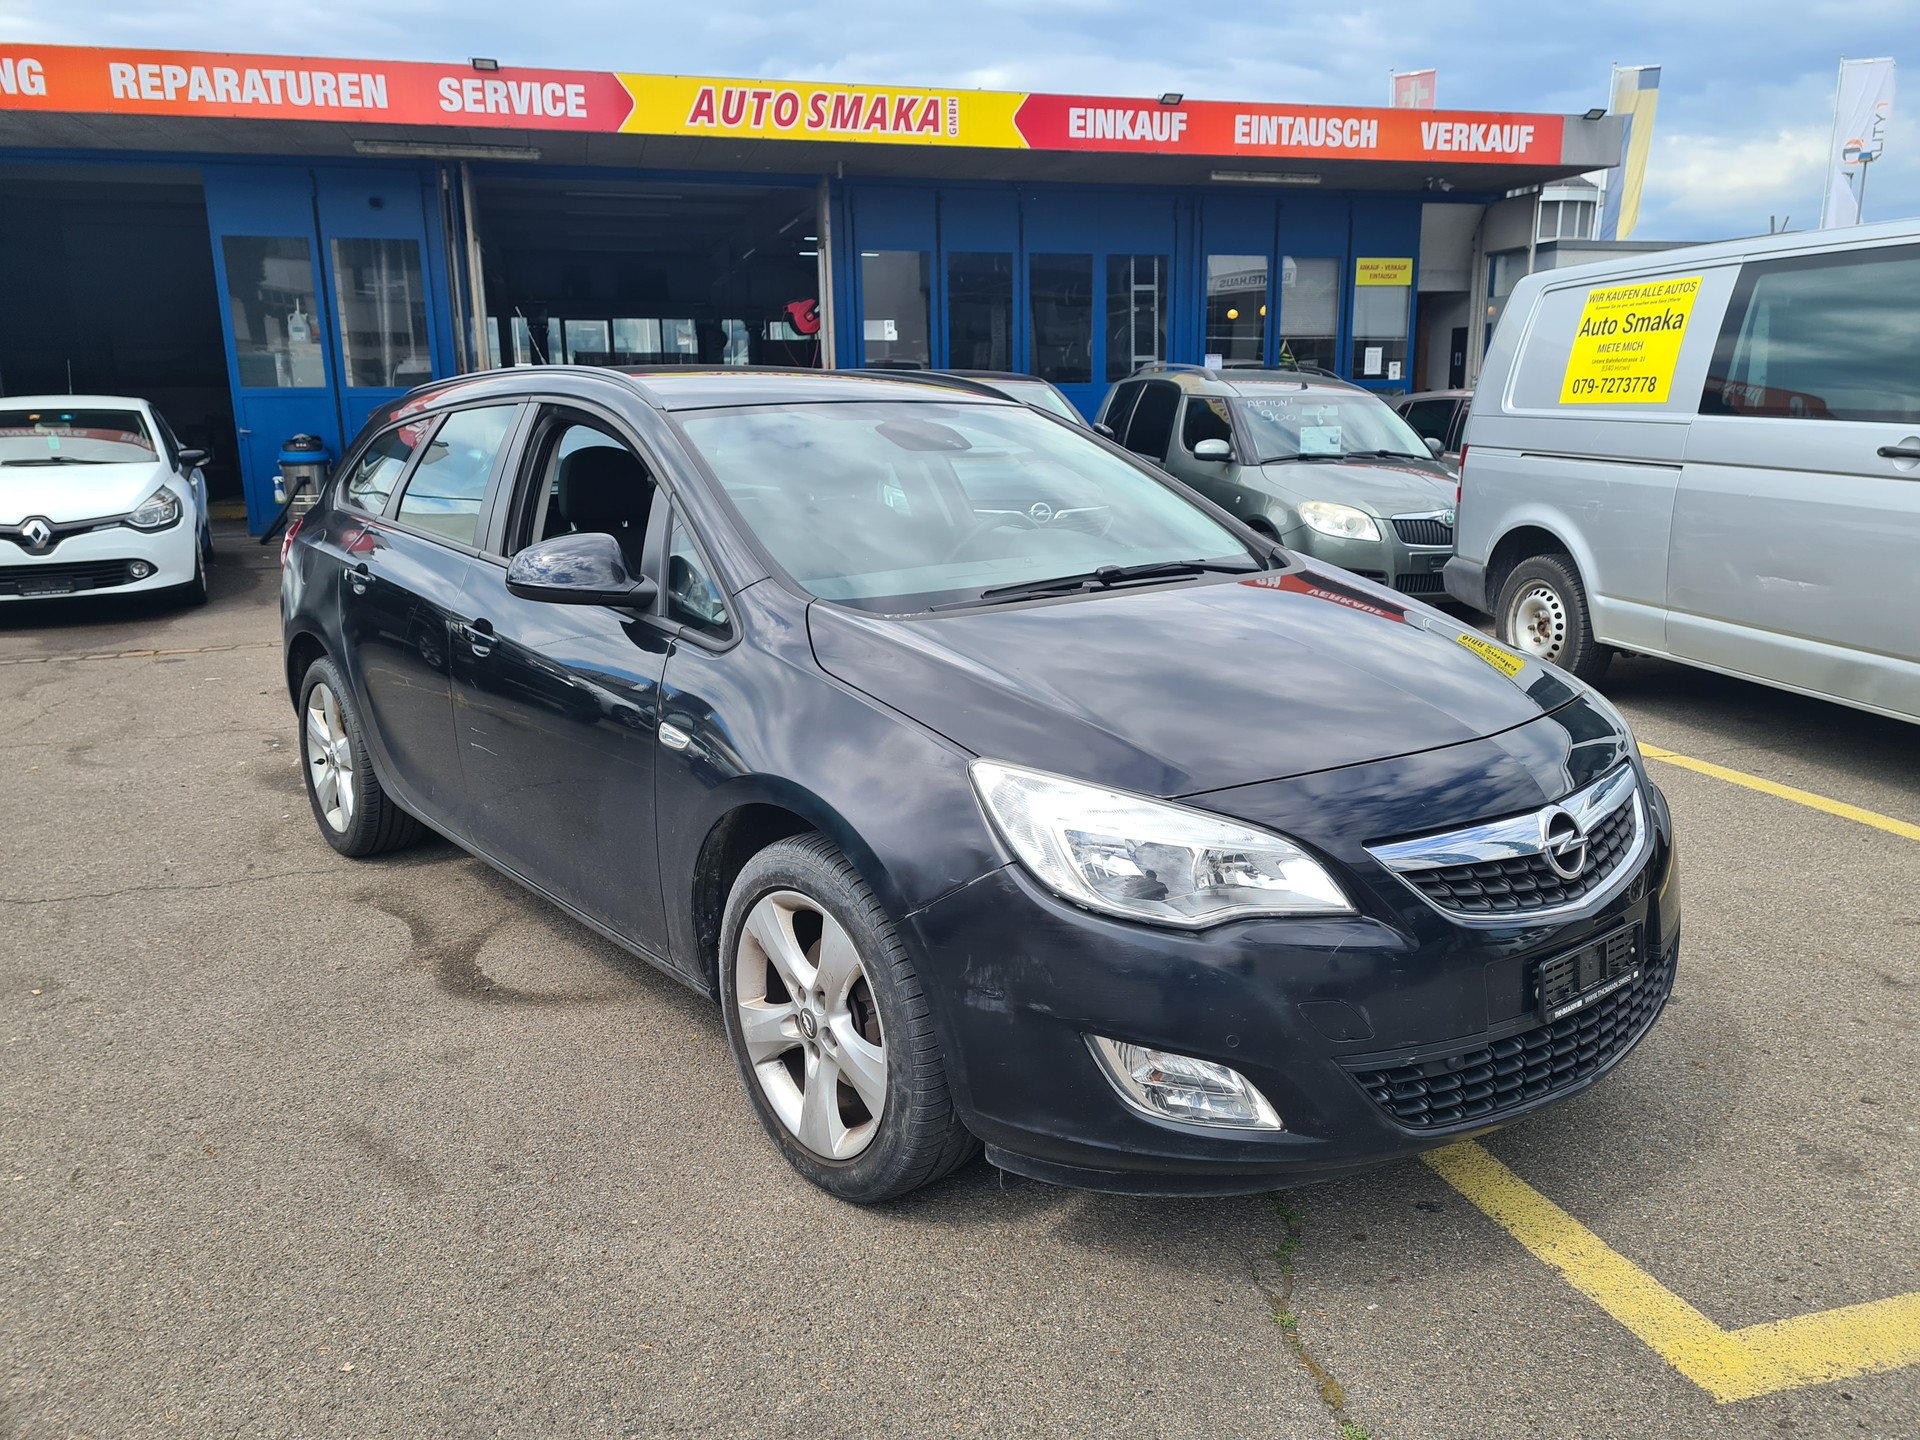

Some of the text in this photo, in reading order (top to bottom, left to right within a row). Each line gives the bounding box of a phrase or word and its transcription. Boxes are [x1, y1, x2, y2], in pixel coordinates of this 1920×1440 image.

[108, 62, 389, 109] REPARATUREN
[437, 76, 588, 118] SERVICE
[686, 86, 942, 135] AUTO SMAKA
[948, 98, 958, 135] GMBH
[1068, 107, 1535, 154] EINKAUF EINTAUSCH VERKAUF
[1589, 292, 1605, 304] WIR
[1606, 289, 1639, 302] KAUFEN
[1641, 285, 1665, 297] ALLE
[1664, 281, 1698, 295] AUTOS
[1578, 308, 1685, 338] Auto Smaka
[1596, 341, 1645, 353] MIETE MICH
[1572, 376, 1658, 395] 079-7273778
